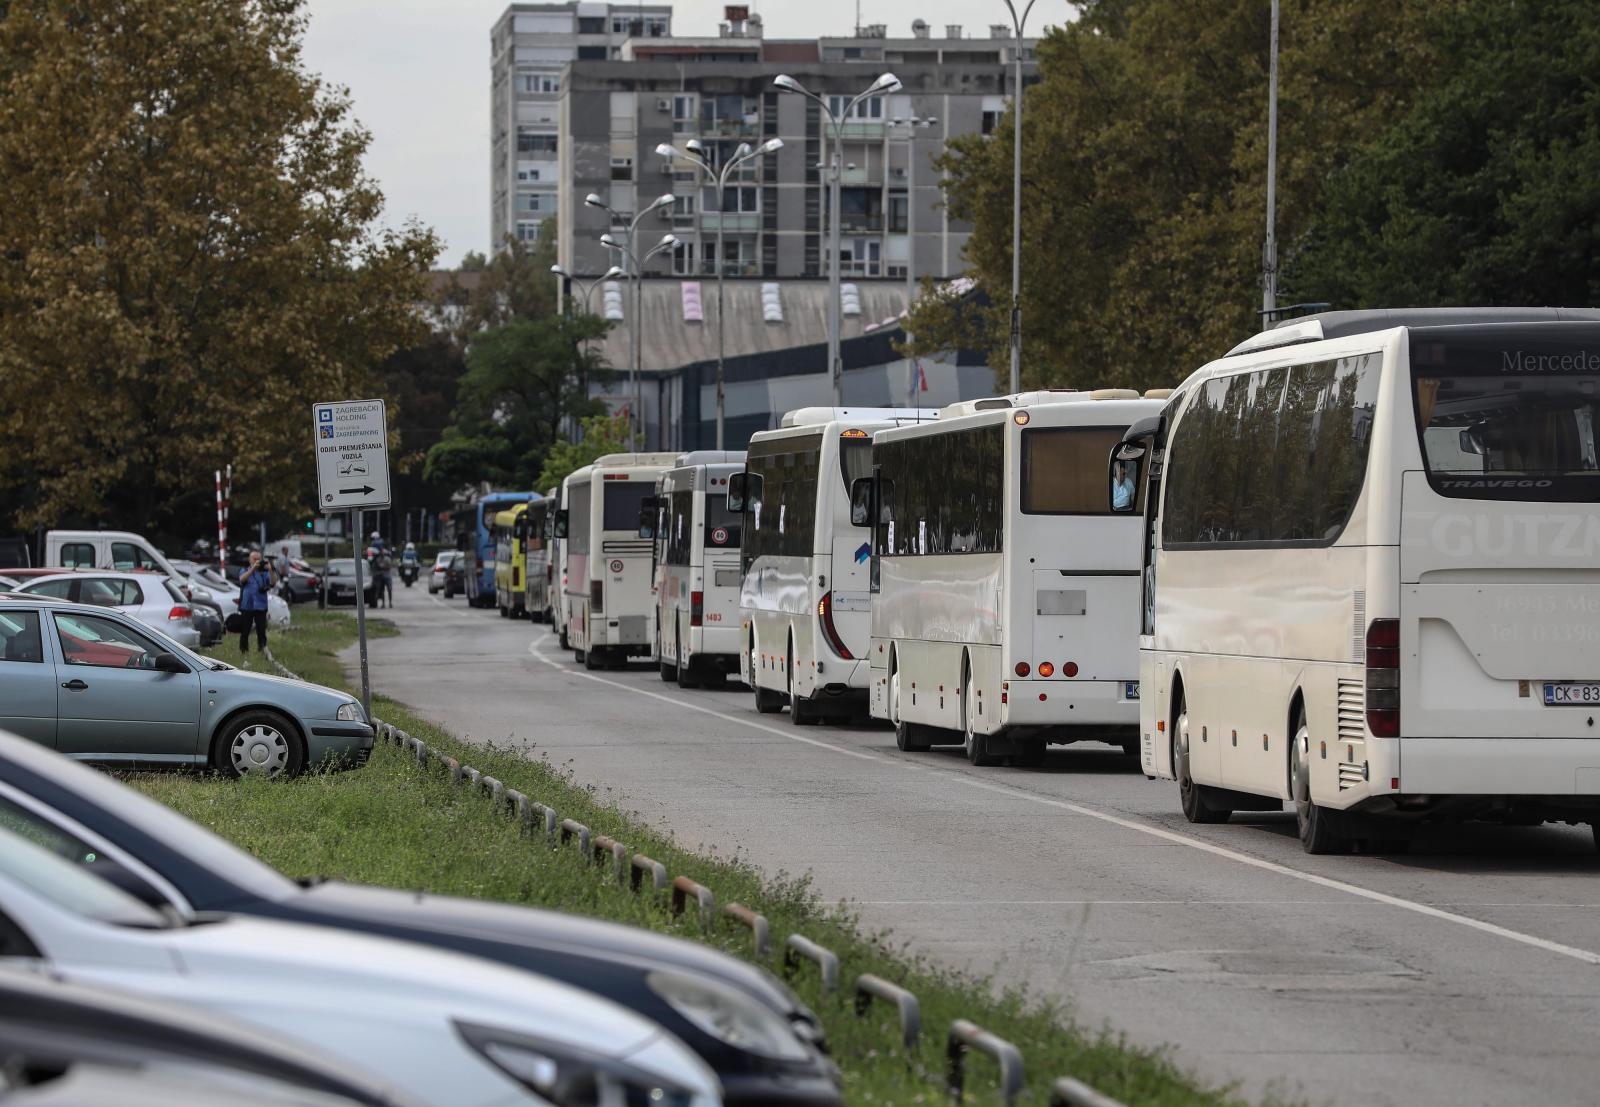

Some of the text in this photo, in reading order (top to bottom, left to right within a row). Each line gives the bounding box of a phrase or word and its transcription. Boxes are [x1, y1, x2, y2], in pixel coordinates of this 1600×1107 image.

[1501, 350, 1600, 372] Mercede
[335, 414, 367, 422] HOLDING
[1440, 479, 1553, 488] TRAVEGO
[1555, 686, 1572, 701] CK
